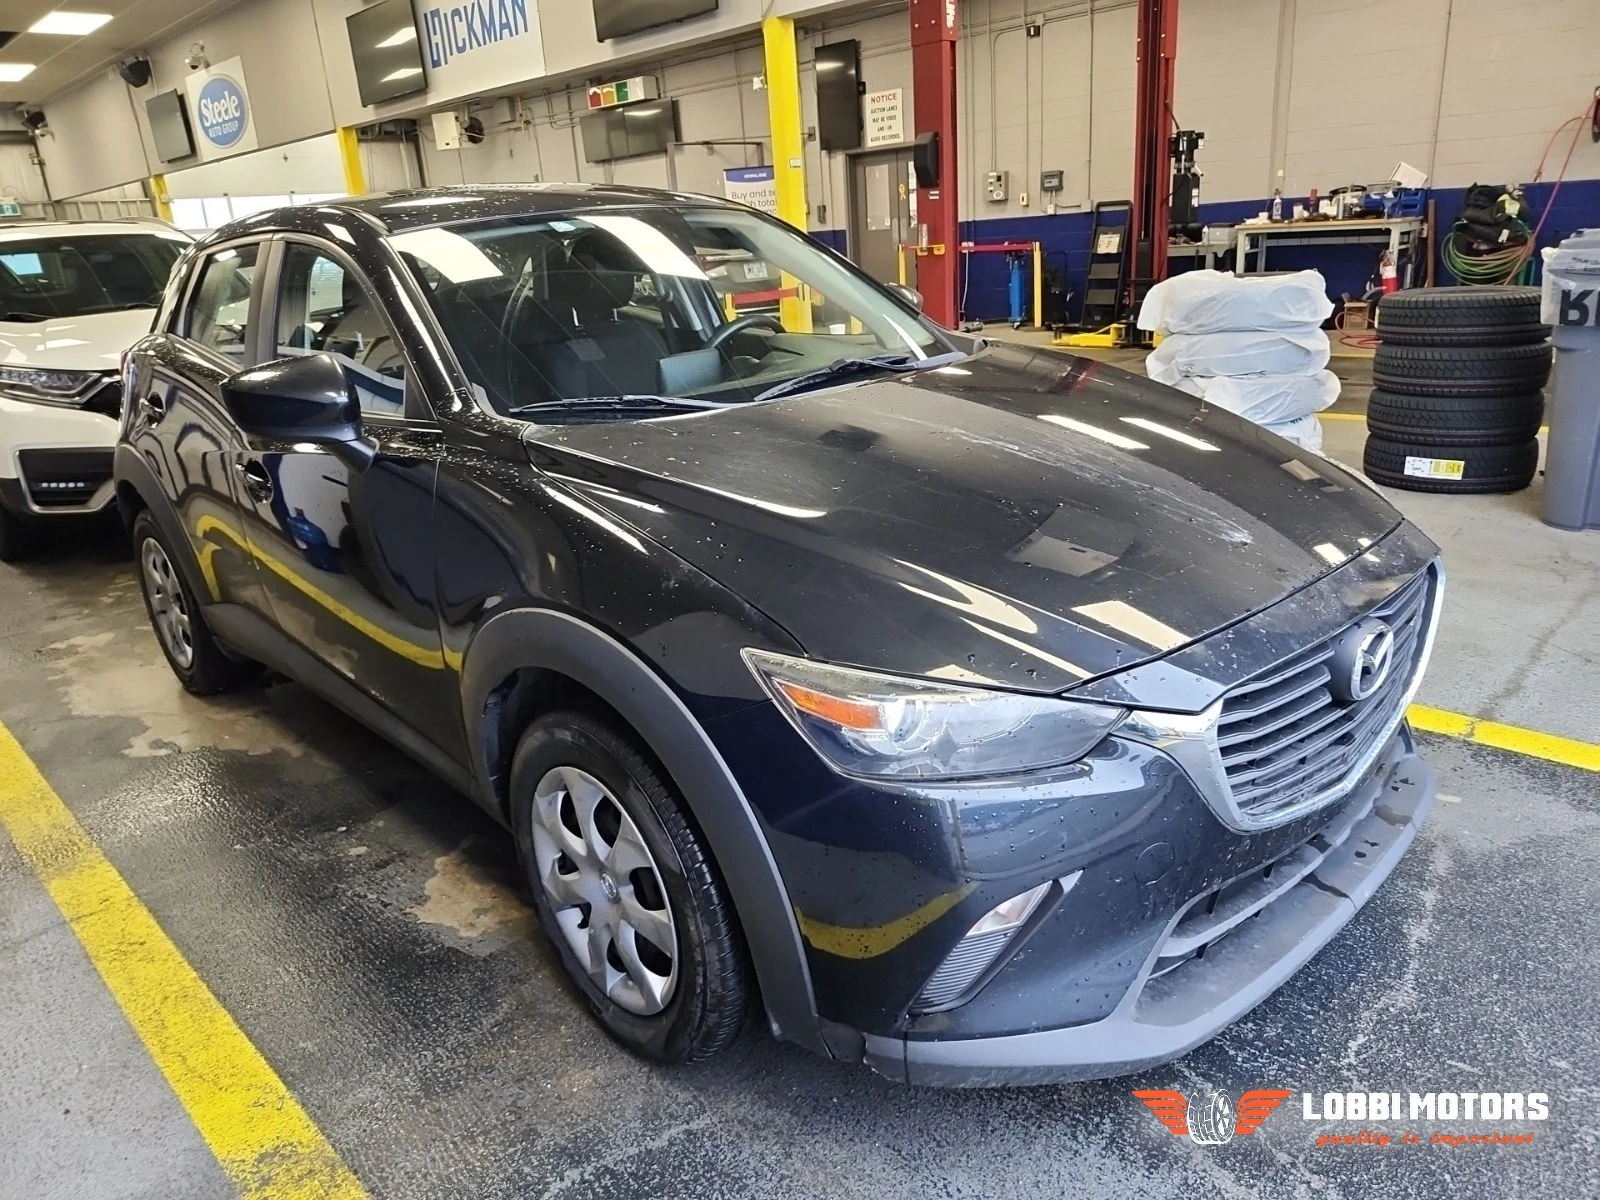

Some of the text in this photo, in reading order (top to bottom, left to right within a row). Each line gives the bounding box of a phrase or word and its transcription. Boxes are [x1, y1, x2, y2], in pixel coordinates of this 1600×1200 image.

[871, 93, 897, 104] NOTICE
[201, 91, 240, 126] Steele
[209, 120, 239, 138] AUTO GROUP
[731, 191, 747, 200] Buy
[749, 189, 767, 198] and
